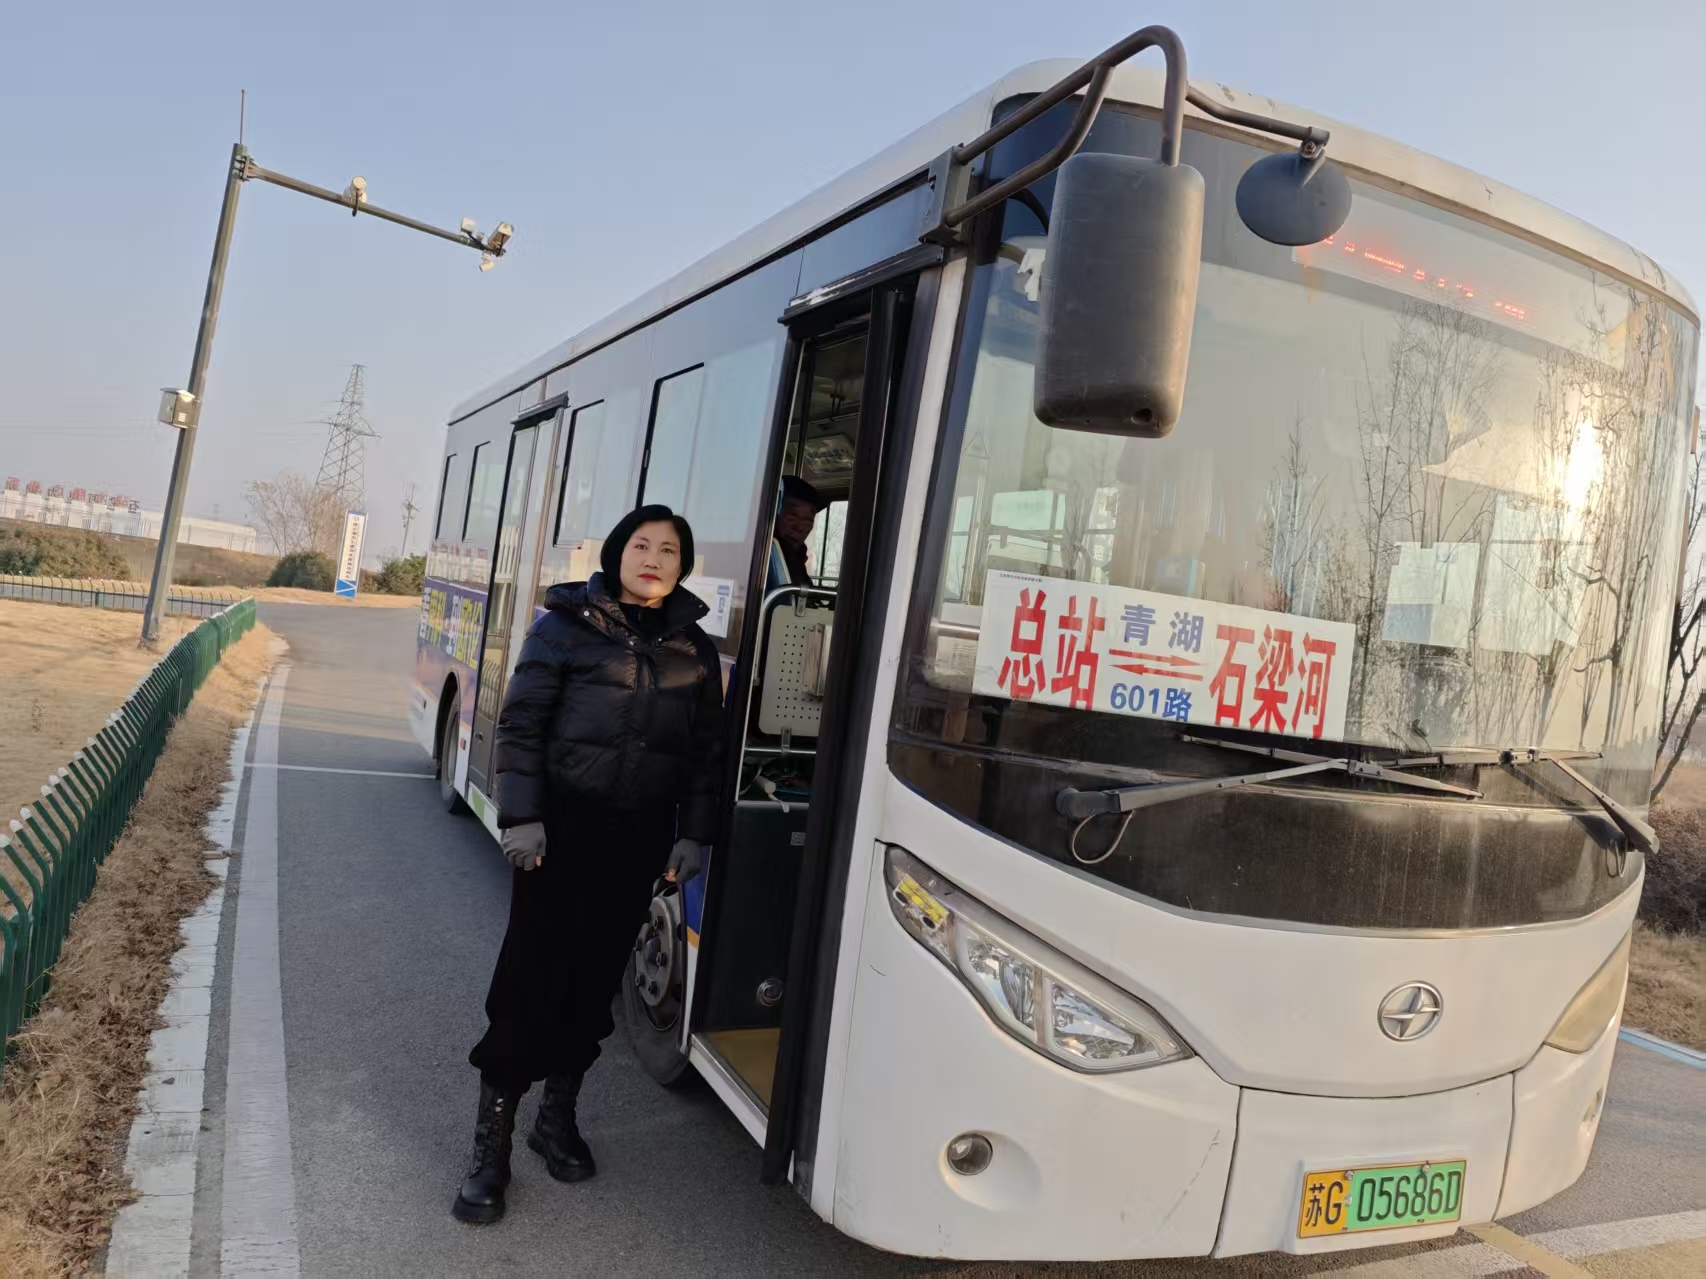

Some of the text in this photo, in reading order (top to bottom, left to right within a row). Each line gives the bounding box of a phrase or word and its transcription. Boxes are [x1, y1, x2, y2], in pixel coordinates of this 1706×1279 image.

[998, 587, 1105, 711] 总站
[1120, 604, 1204, 654] 青湖
[1110, 682, 1193, 722] 601路
[1209, 624, 1337, 740] 石梁河
[1305, 1170, 1462, 1227] 苏G 05686D
